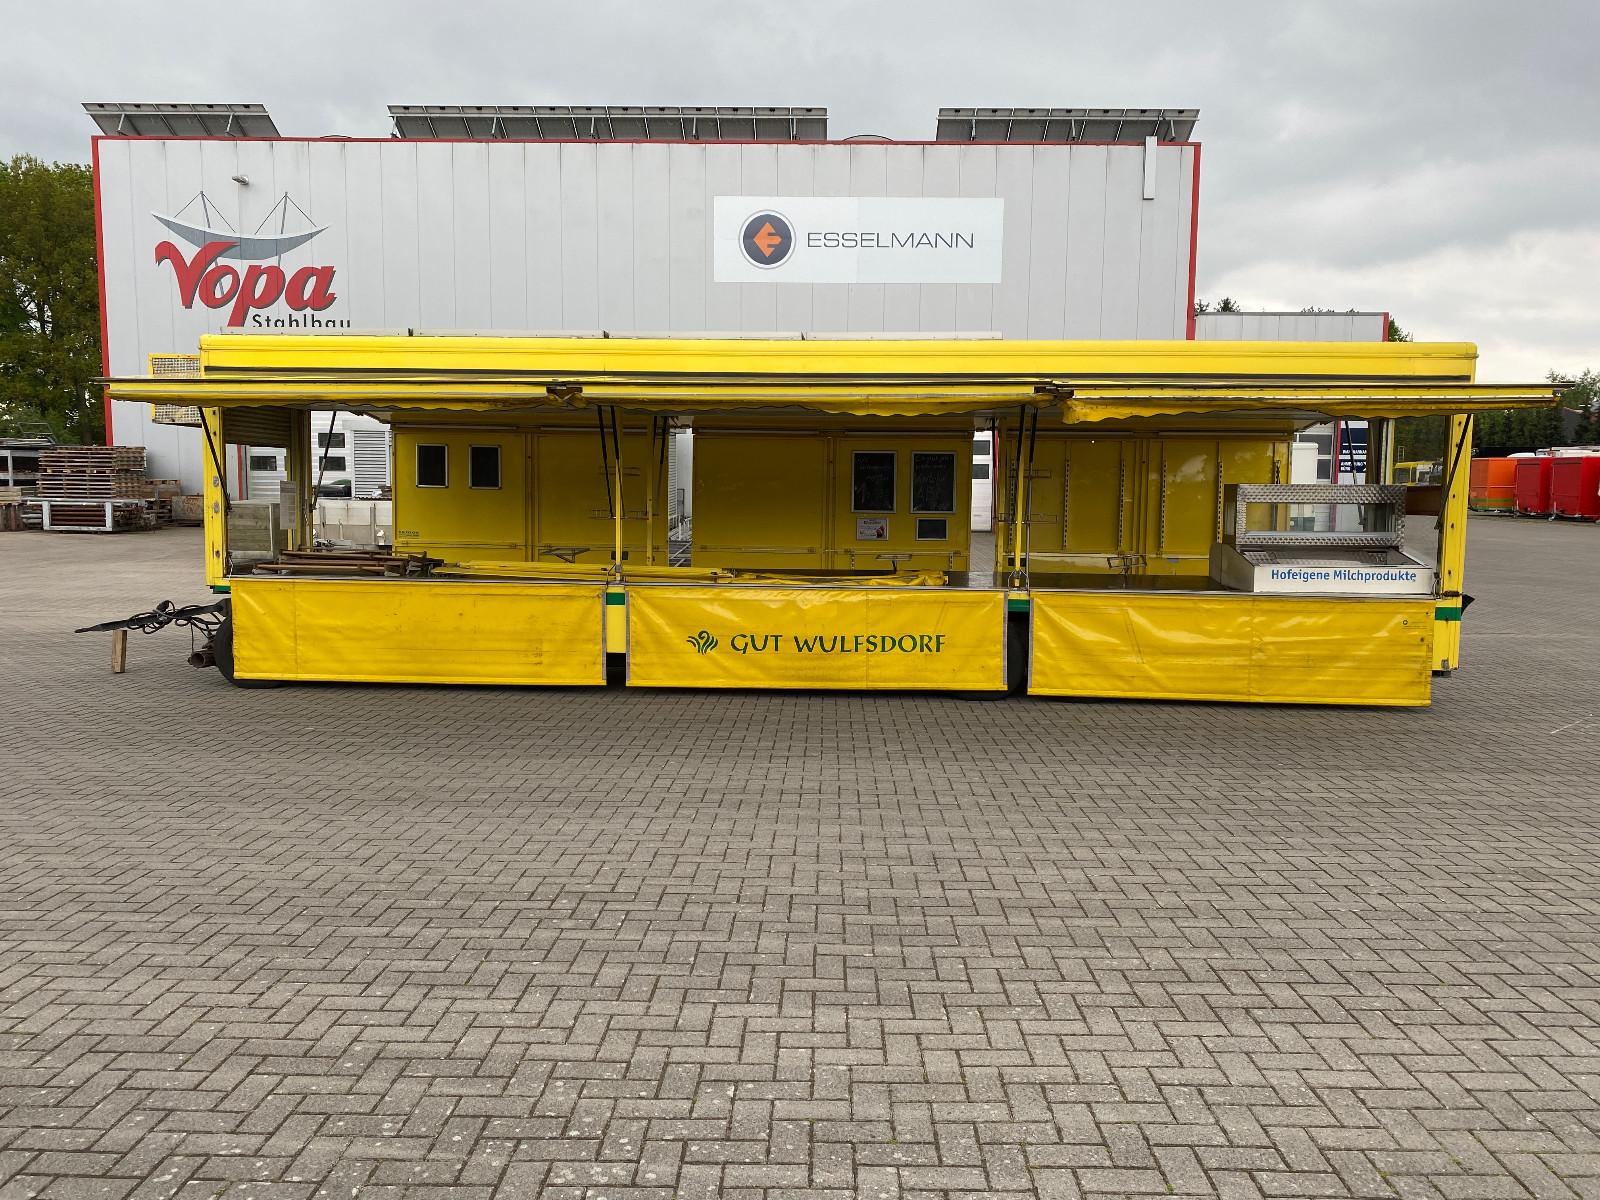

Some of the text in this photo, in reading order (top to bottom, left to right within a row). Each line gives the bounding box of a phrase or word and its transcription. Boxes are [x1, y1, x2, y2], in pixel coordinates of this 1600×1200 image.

[807, 232, 974, 248] ESSELMANN
[154, 240, 337, 327] Vopa
[1271, 569, 1417, 583] Hofeigene Milchprodukte
[730, 634, 946, 654] GUT WULFSDORF
